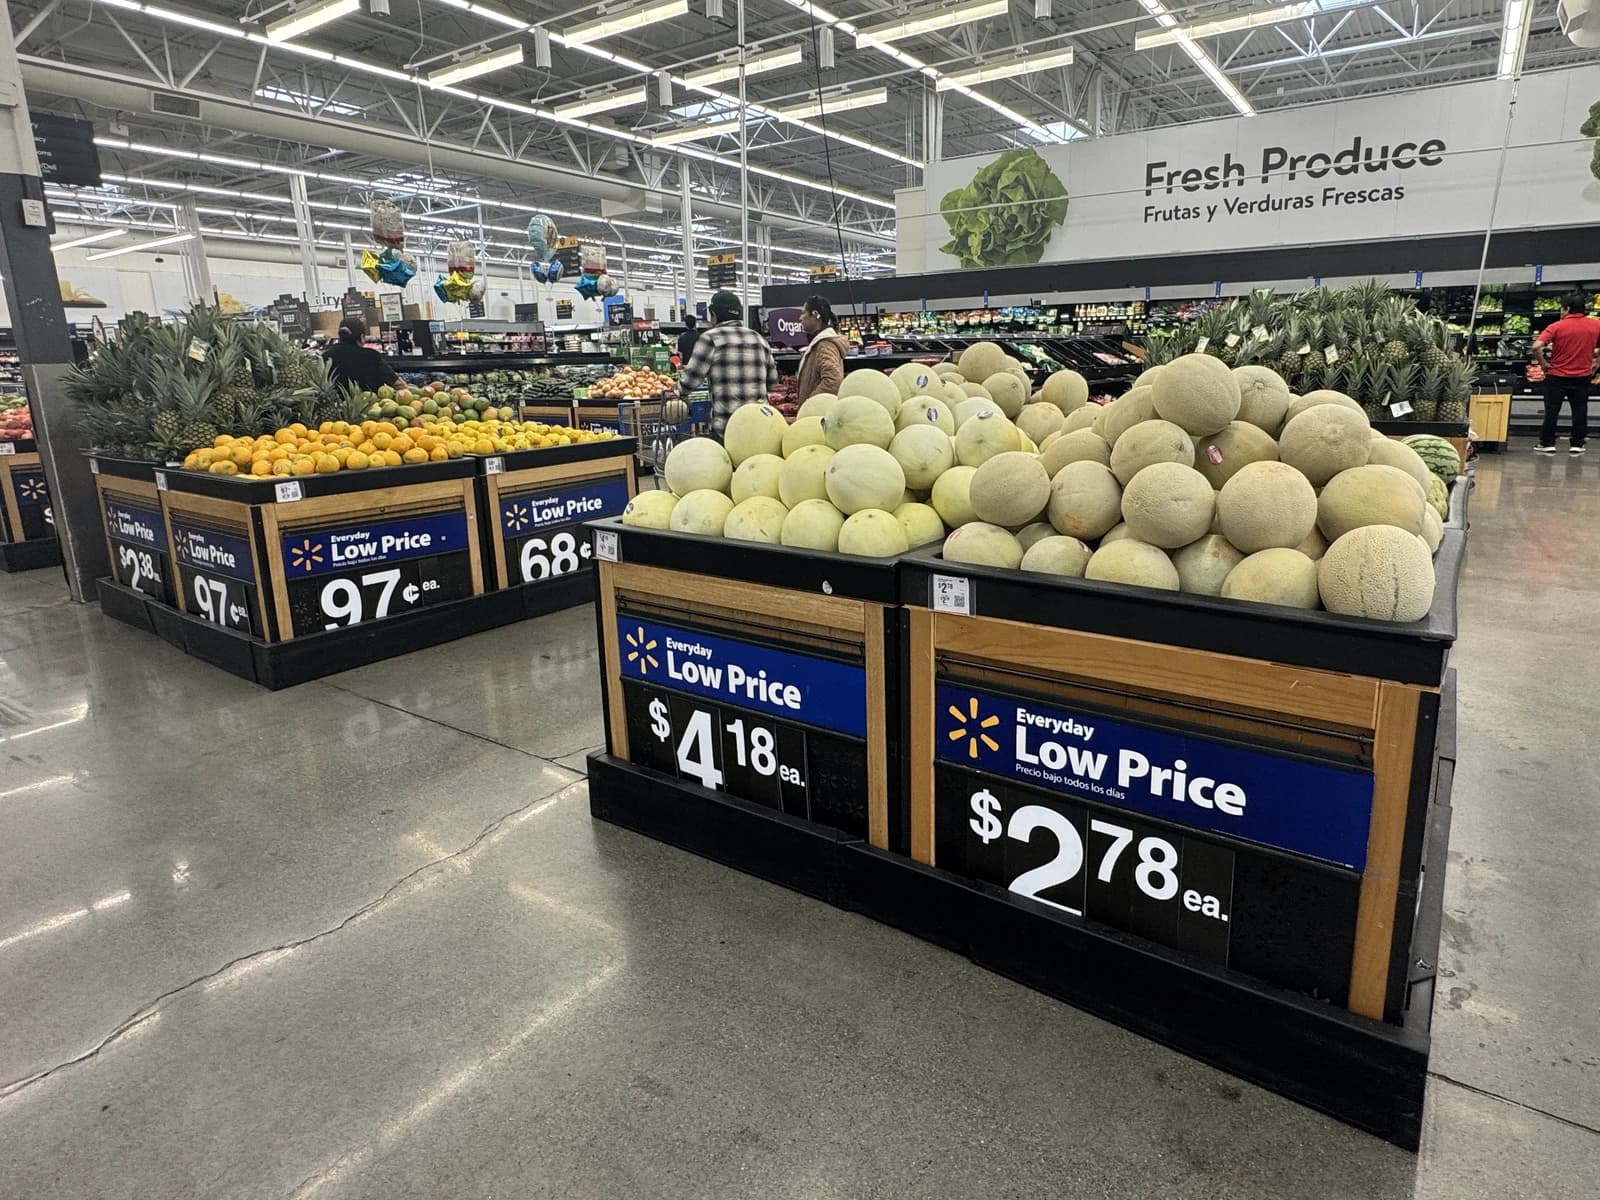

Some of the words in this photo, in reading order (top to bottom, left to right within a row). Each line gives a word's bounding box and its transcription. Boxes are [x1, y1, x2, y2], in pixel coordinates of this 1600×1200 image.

[1145, 153, 1245, 196] Fresh
[1261, 136, 1446, 183] Produce
[1144, 205, 1201, 223] Frutas
[1206, 204, 1218, 222] y
[1223, 194, 1314, 214] Verduras
[1322, 186, 1405, 206] Frescas
[777, 318, 805, 337] Organ
[532, 505, 565, 523] Low
[566, 496, 603, 516] Price
[119, 518, 134, 537] Low
[134, 521, 154, 541] Price
[330, 531, 370, 543] Everyday
[189, 539, 209, 561] Low
[209, 544, 235, 568] Price
[331, 542, 378, 562] Low
[381, 532, 432, 554] Price
[422, 580, 441, 592] ea.
[666, 637, 713, 660] Everyday
[666, 650, 723, 690] Low
[727, 665, 802, 710] Price
[1016, 708, 1095, 742] Everyday
[779, 764, 806, 787] ea.
[1015, 725, 1109, 781] Low
[1117, 748, 1247, 817] Price
[1015, 763, 1042, 779] Precio
[1043, 770, 1063, 784] bajo
[1063, 776, 1090, 791] todos
[1091, 782, 1105, 794] los
[1105, 787, 1126, 800] días
[1183, 889, 1229, 922] ea.
